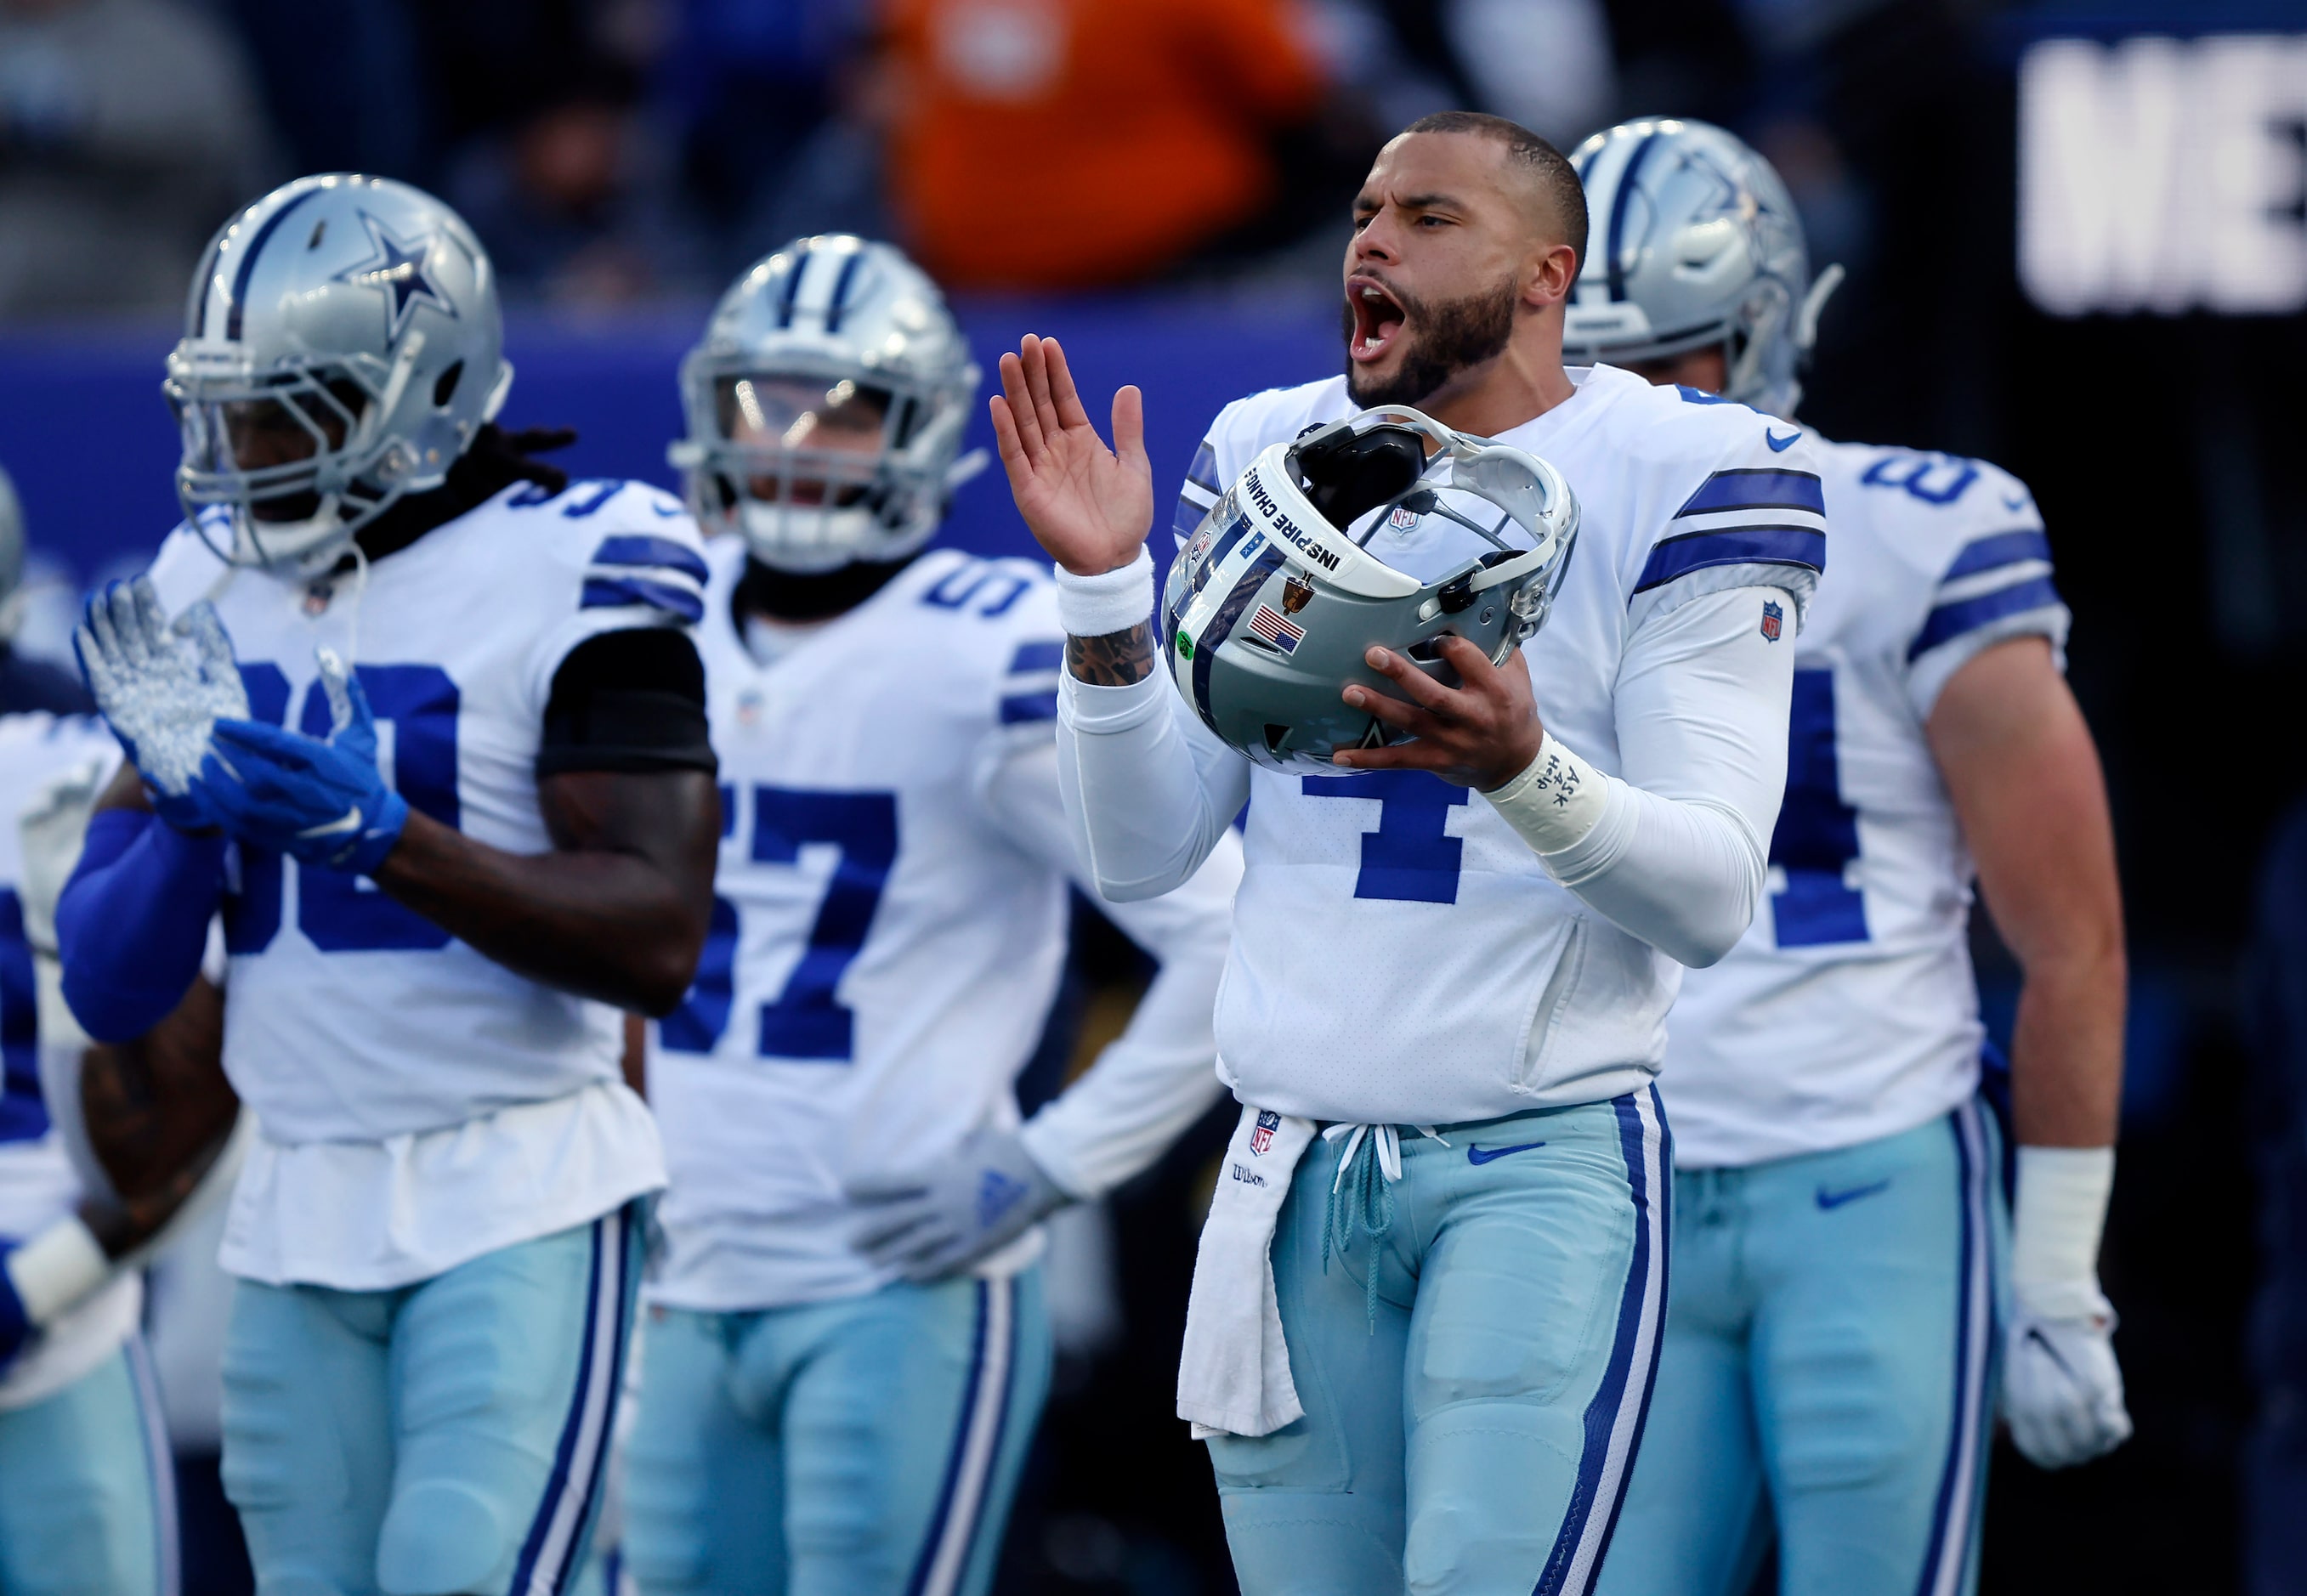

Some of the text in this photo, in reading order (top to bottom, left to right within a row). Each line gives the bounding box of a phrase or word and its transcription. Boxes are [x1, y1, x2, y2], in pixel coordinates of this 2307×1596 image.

[1392, 509, 1414, 527] NFL
[1273, 513, 1341, 572] INSPIRE
[1251, 1127, 1274, 1154] NFL
[1233, 1163, 1266, 1188] Wilson
